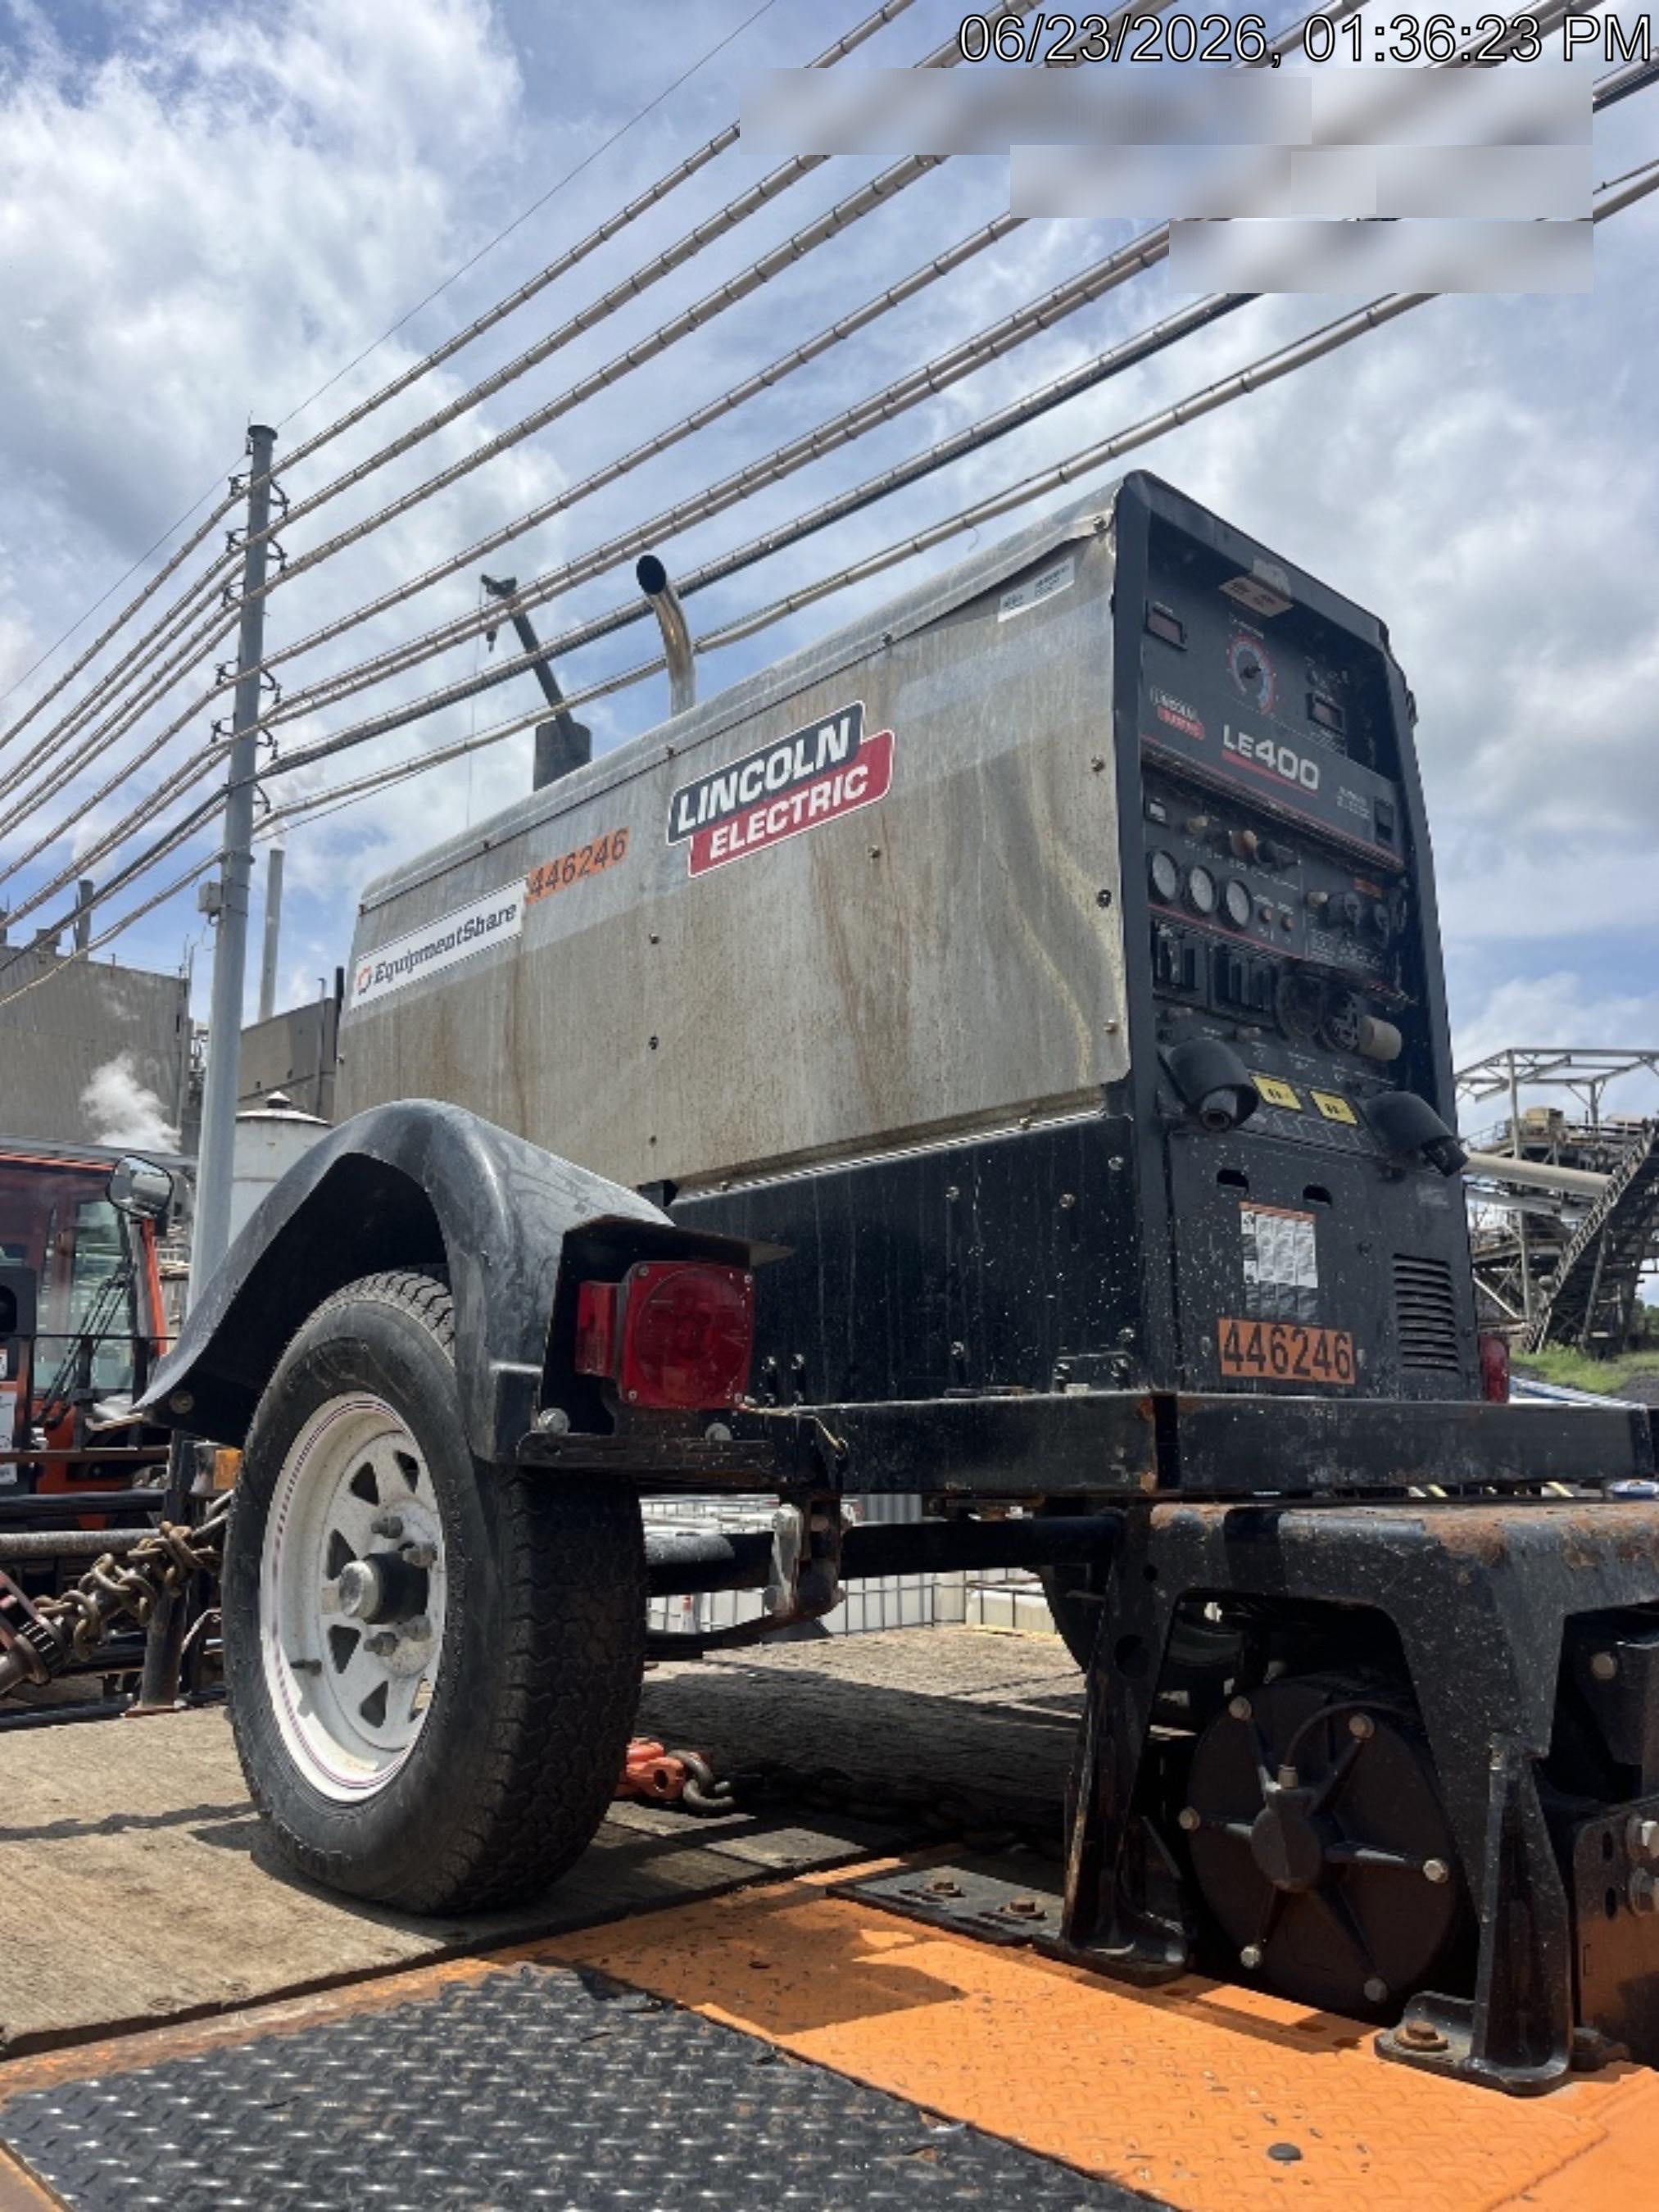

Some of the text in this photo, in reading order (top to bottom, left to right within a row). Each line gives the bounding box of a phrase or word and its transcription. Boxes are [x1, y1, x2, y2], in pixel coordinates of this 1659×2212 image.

[678, 717, 851, 833] LINCOLN
[1223, 724, 1319, 790] LE400
[709, 765, 868, 859] ELECTRIC
[529, 828, 628, 898] 446246
[374, 903, 517, 985] EquipmentShare
[1224, 1322, 1351, 1379] 446246
